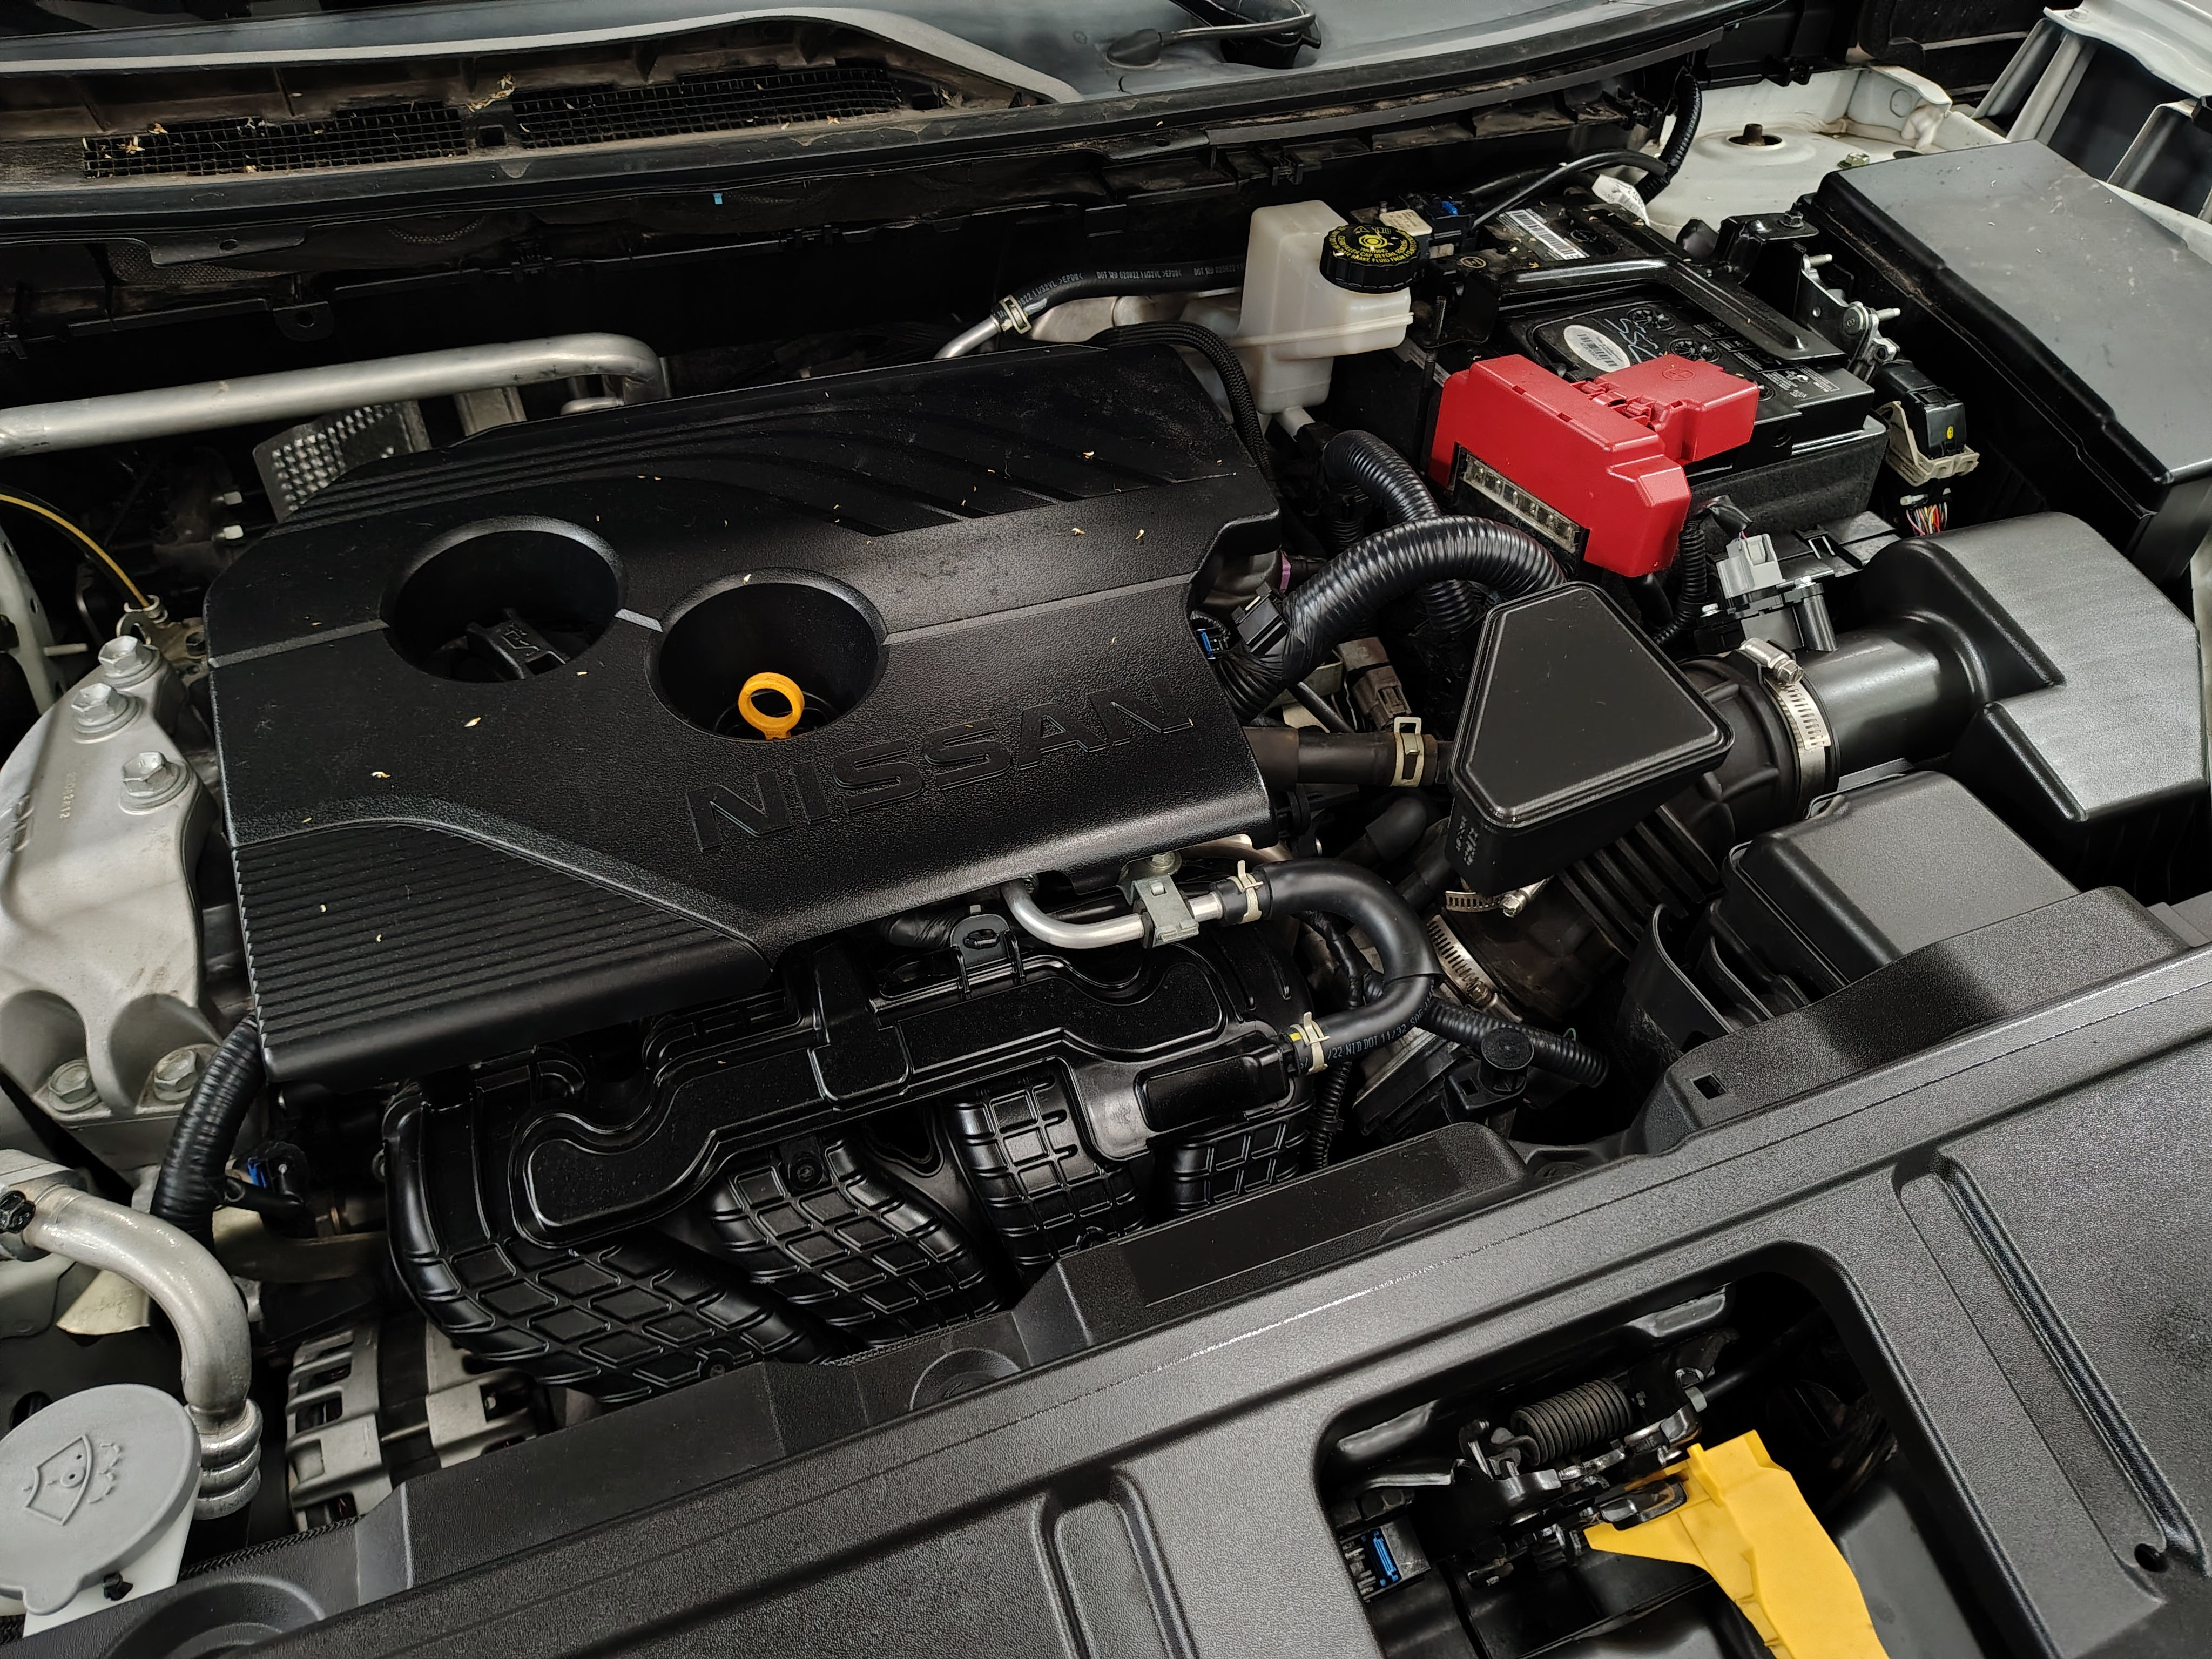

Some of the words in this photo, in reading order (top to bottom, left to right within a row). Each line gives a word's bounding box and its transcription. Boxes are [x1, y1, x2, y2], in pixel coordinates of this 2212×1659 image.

[1351, 254, 1370, 262] BRAKE
[685, 677, 1193, 853] NISSAN
[1363, 1035, 1379, 1050] DOT
[1380, 1023, 1407, 1043] 11/32
